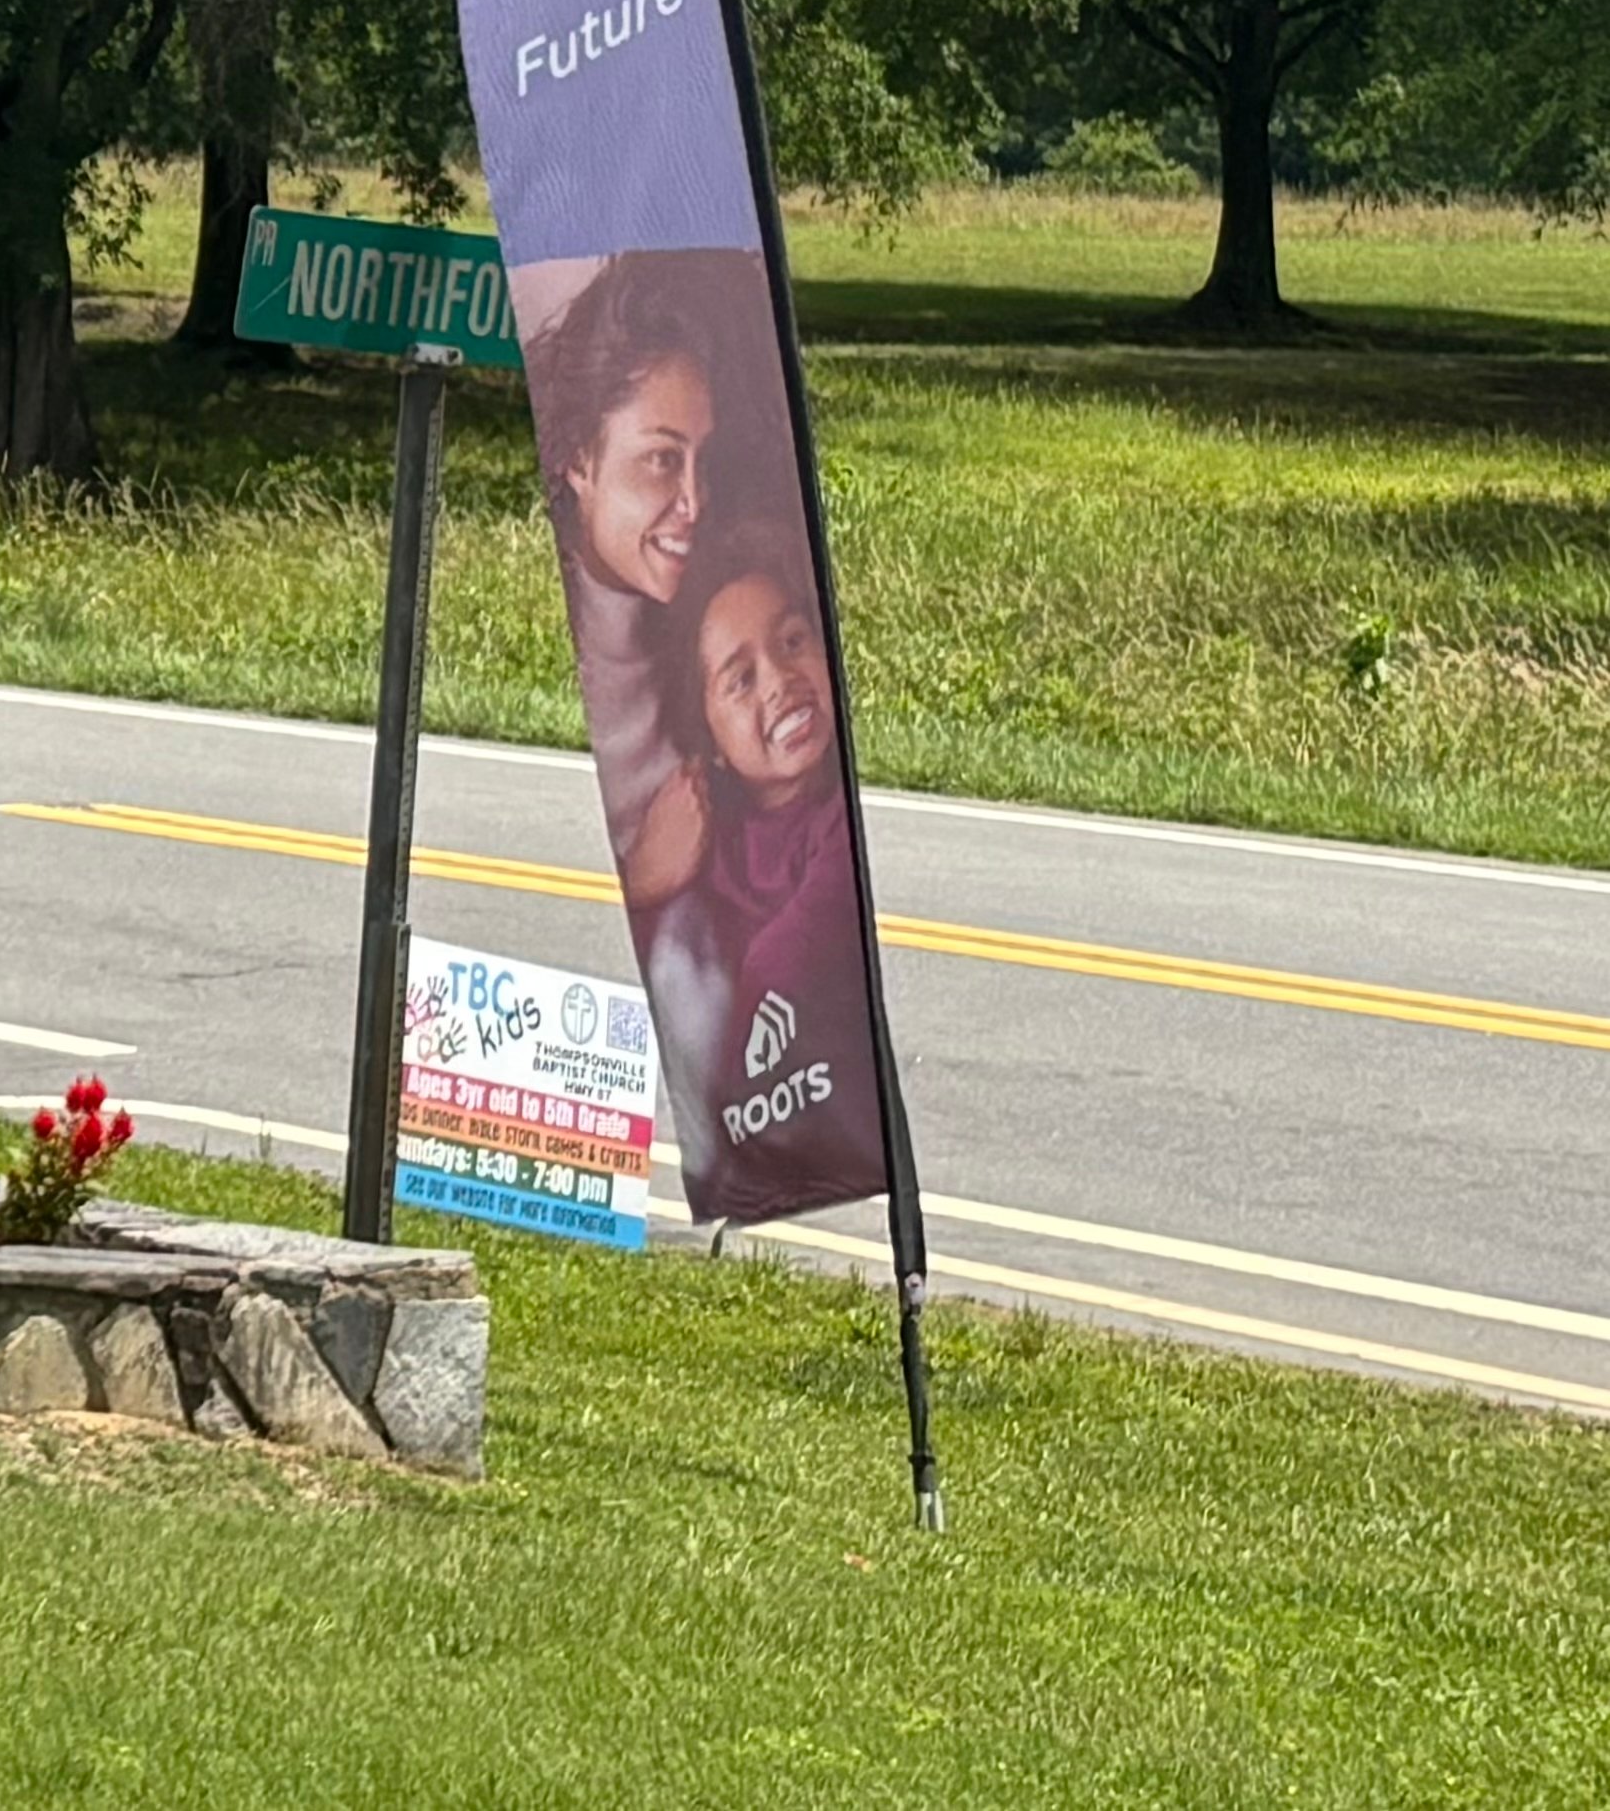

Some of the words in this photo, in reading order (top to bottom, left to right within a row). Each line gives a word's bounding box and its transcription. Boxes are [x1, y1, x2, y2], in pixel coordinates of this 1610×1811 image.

[448, 962, 514, 1015] TBC
[407, 1066, 453, 1102] Ages
[455, 1077, 486, 1111] 3yr
[489, 1086, 518, 1116] old
[522, 1090, 540, 1122] to
[543, 1096, 574, 1129] 5th
[578, 1104, 630, 1141] Grade
[533, 1056, 587, 1079] BAPTIST
[591, 1069, 645, 1093] CHURCH
[722, 1062, 832, 1145] ROOTS
[396, 1133, 472, 1173] undays:
[476, 1148, 518, 1184] 5:30
[533, 1160, 575, 1196] 7:00
[577, 1174, 608, 1203] pm
